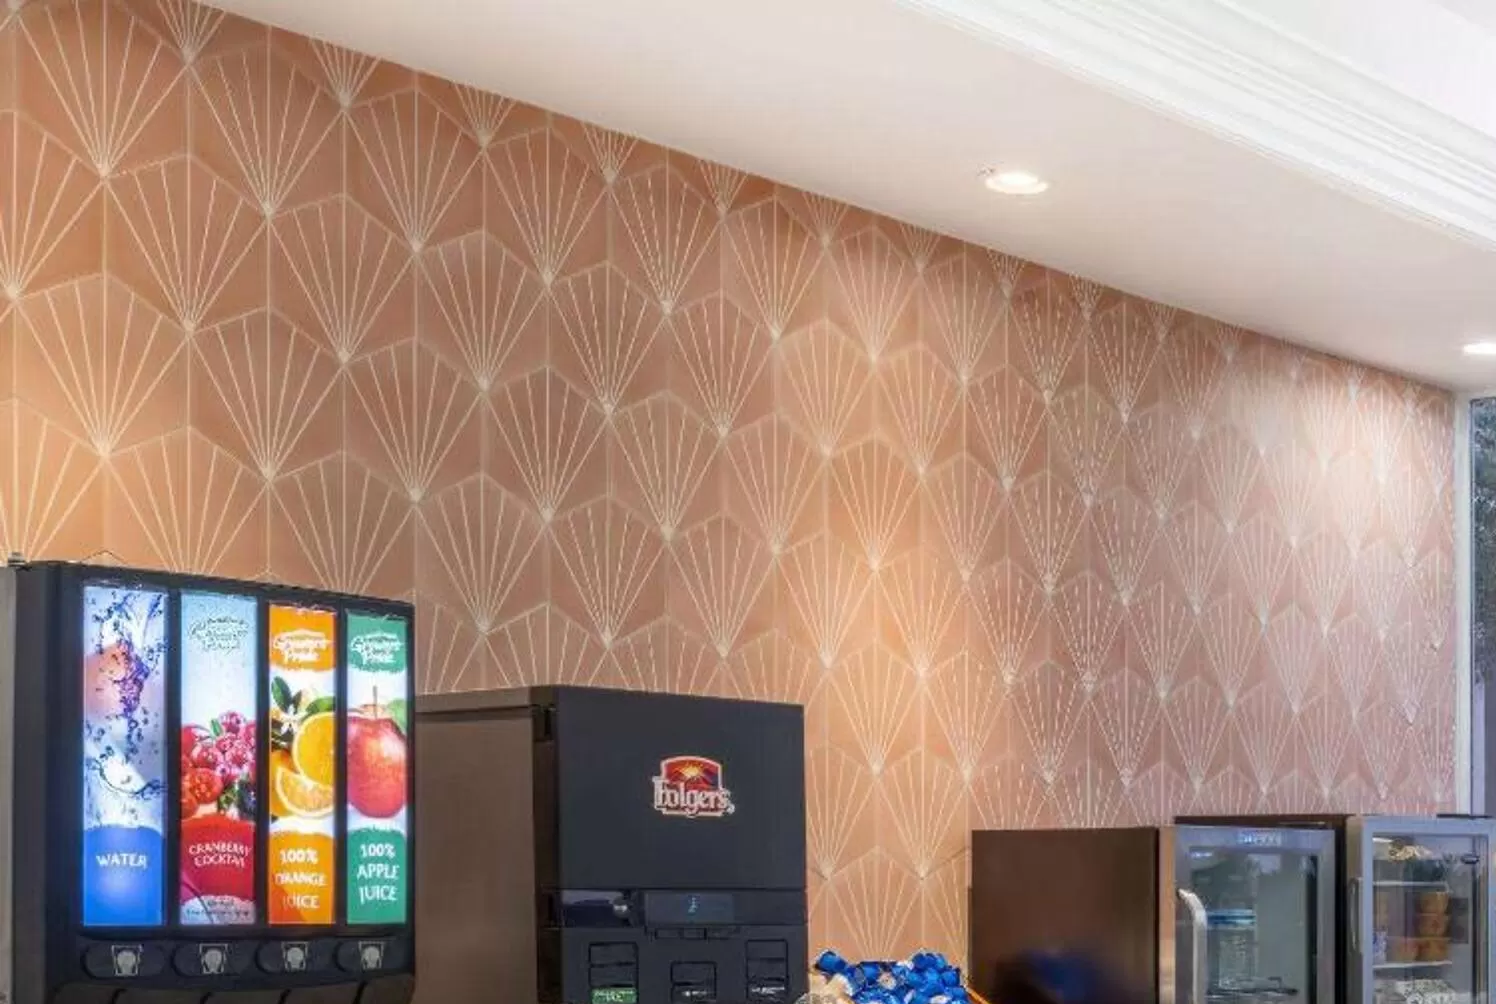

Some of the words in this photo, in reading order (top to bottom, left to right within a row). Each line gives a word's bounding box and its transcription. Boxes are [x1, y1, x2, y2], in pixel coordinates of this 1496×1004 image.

[652, 775, 731, 818] Folgers
[279, 847, 319, 865] 100%
[360, 843, 396, 859] 100%
[96, 853, 148, 869] WATER
[274, 871, 328, 887] ORANGE
[356, 863, 400, 881] APPLE
[282, 894, 320, 911] JUICE
[358, 885, 398, 905] JUICE
